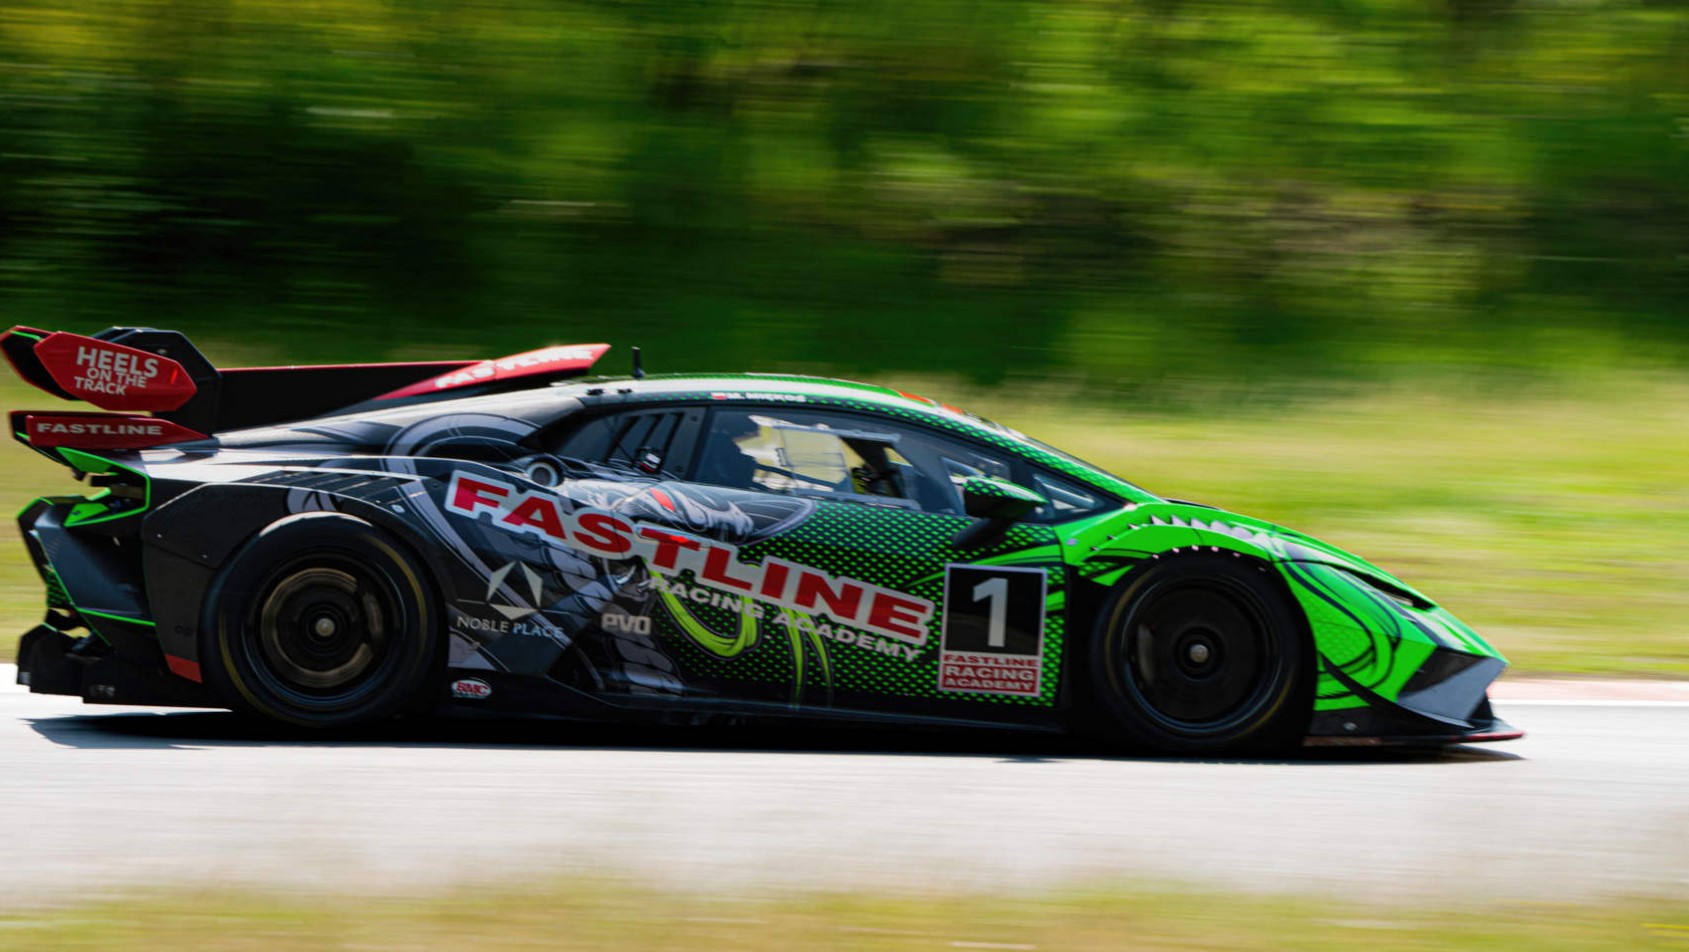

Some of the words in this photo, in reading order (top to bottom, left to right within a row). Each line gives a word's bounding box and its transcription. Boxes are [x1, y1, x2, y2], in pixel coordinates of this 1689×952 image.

[76, 346, 159, 379] HEELS
[74, 376, 127, 396] TRACK
[86, 368, 112, 382] ON
[115, 371, 147, 388] THE
[36, 422, 163, 436] FASTLINE
[449, 472, 930, 642] FASTLINE
[647, 576, 765, 619] RACING
[772, 610, 922, 662] ACADEMY
[972, 576, 1009, 648] 1
[456, 615, 509, 633] NOBLE
[512, 622, 565, 638] PLACE
[943, 654, 1040, 667] FASTLINE
[944, 666, 1034, 681] RACING
[944, 677, 1034, 691] ACADEMY
